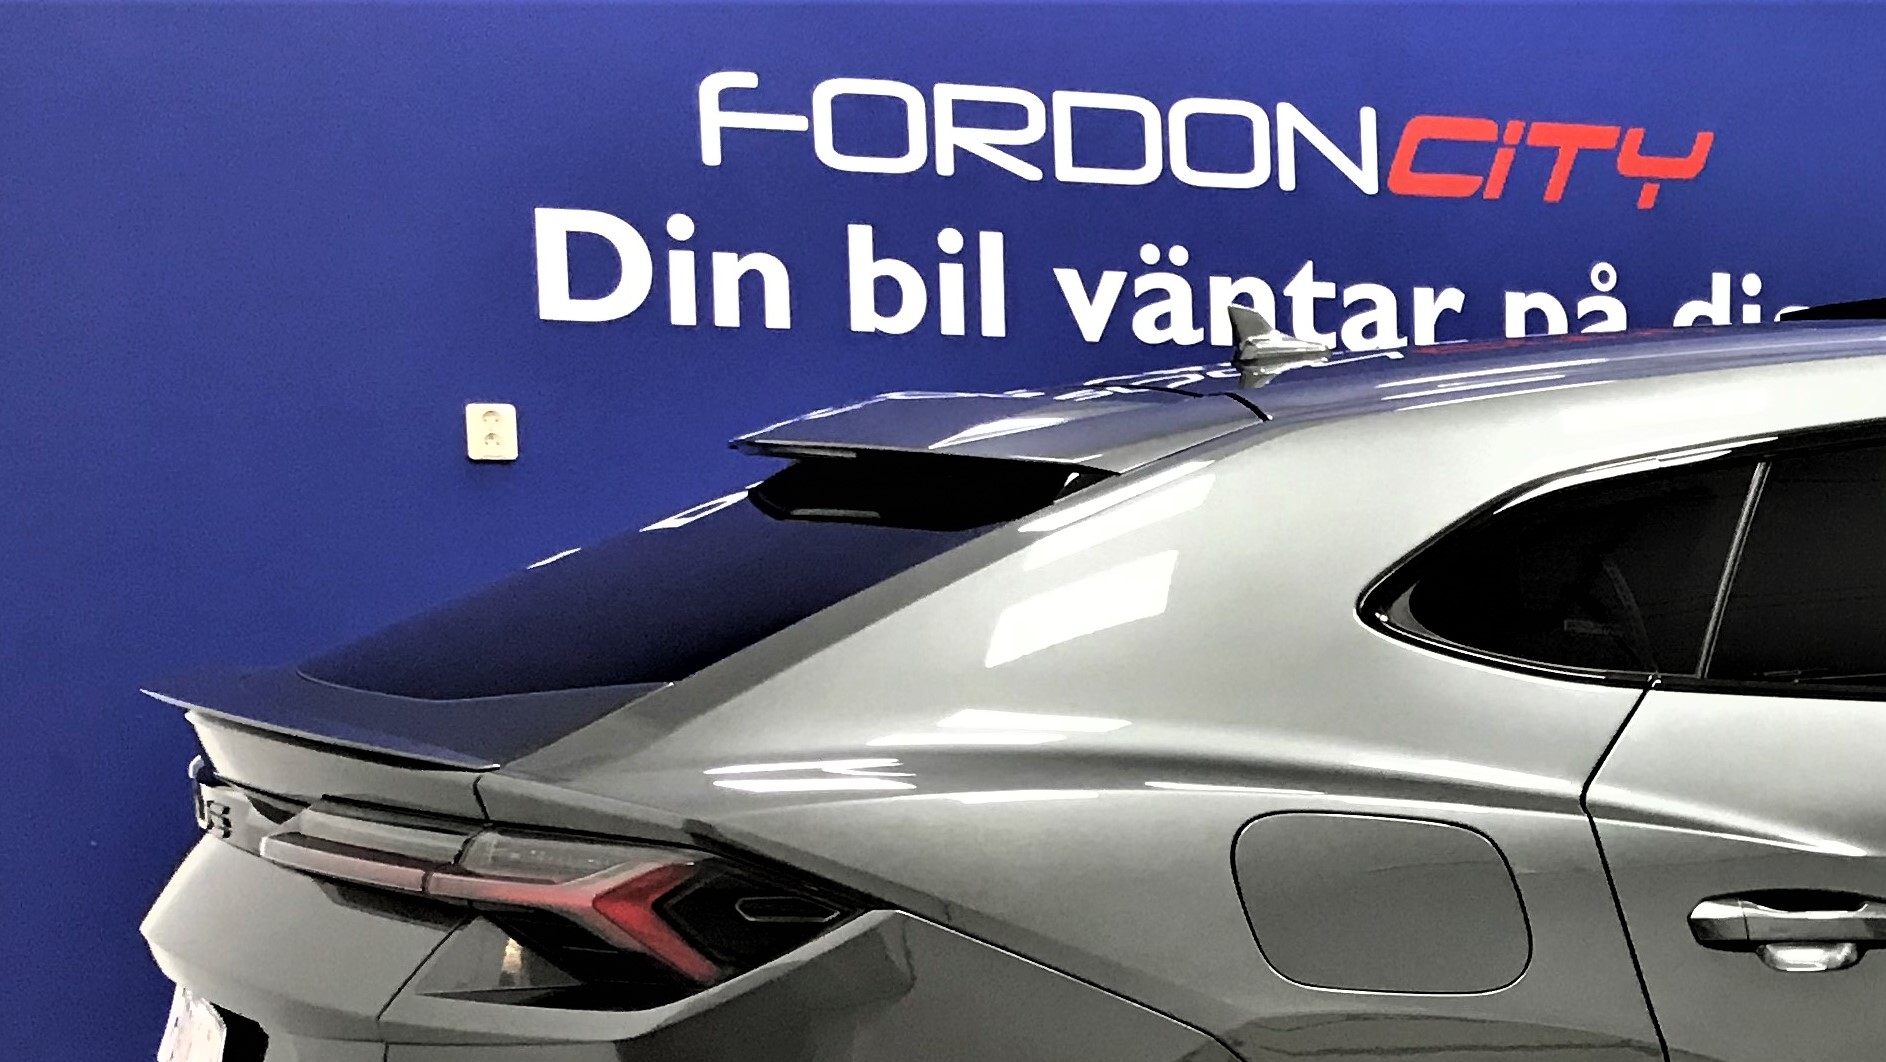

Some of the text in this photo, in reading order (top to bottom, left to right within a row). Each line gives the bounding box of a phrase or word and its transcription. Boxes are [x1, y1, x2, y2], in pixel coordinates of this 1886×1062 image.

[534, 207, 791, 330] Din
[847, 223, 1007, 337] bil
[1052, 243, 1466, 352] väntar
[1673, 272, 1811, 327] di
